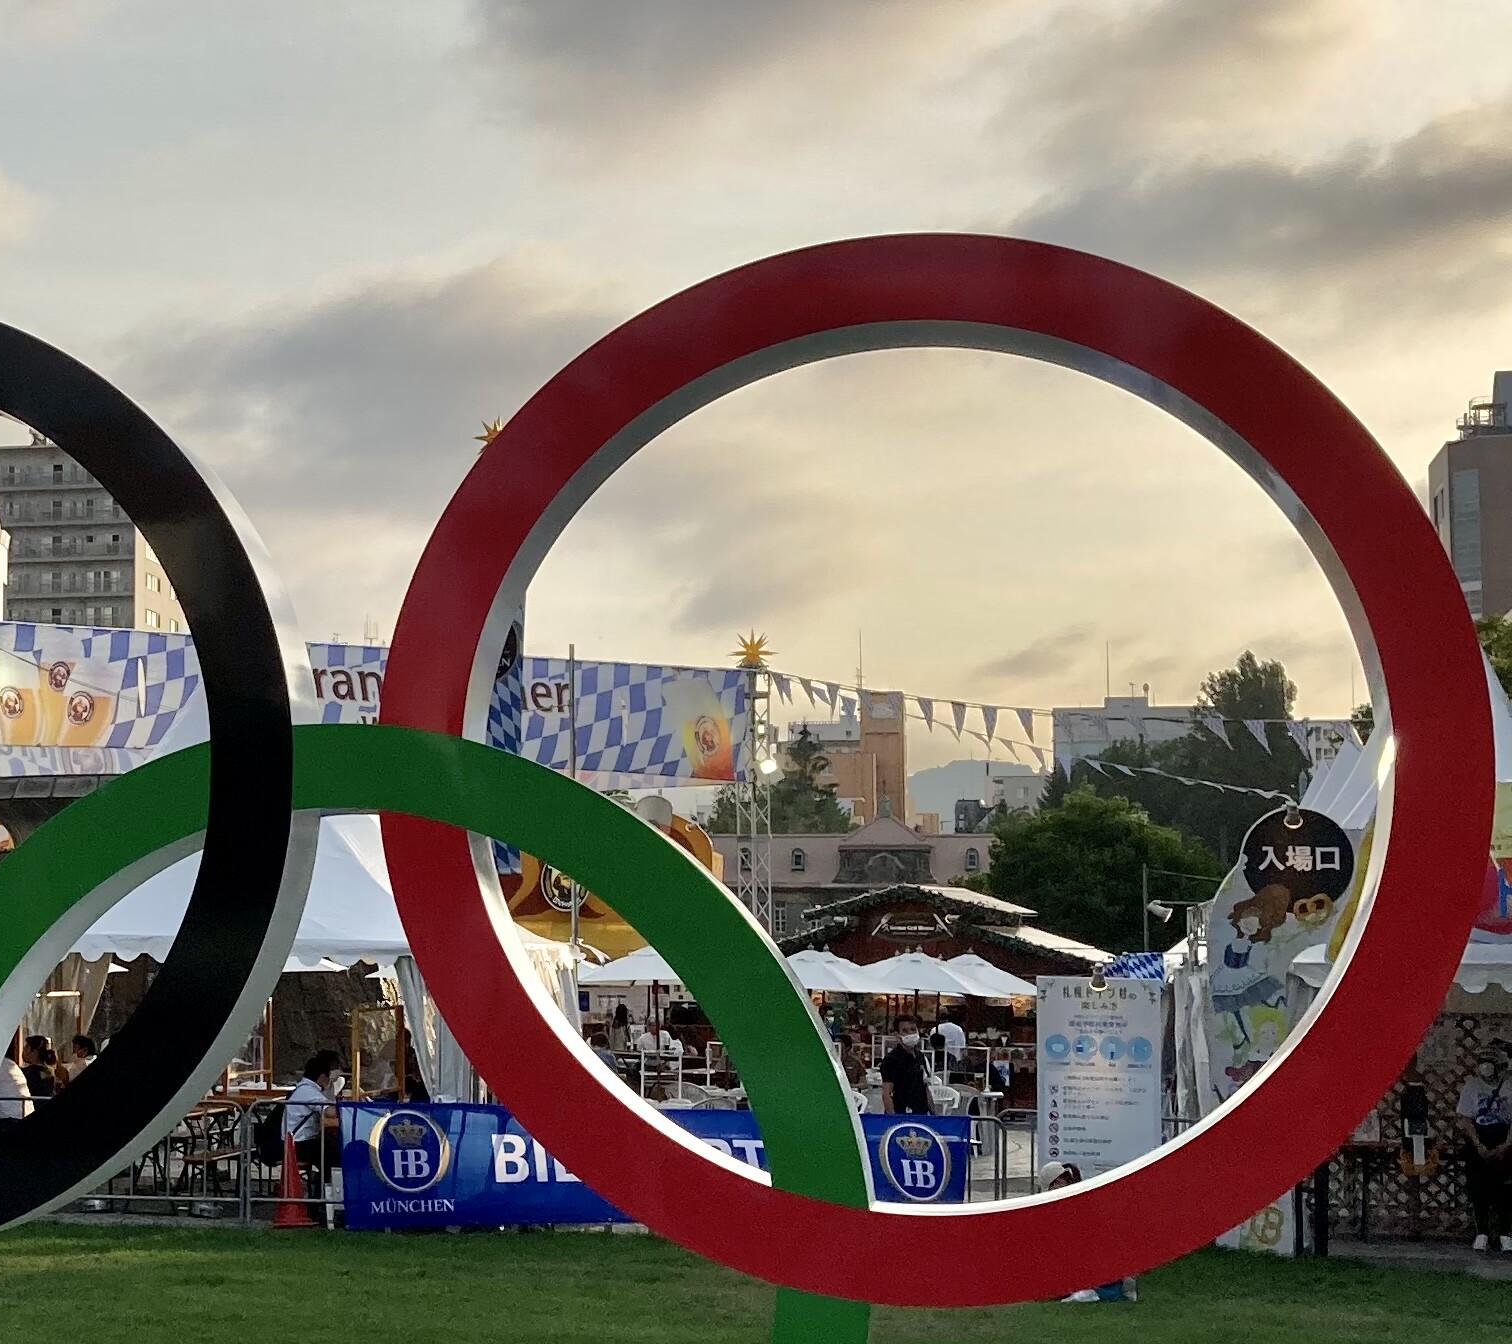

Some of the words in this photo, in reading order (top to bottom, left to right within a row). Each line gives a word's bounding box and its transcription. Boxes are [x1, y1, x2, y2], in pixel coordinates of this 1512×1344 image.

[1258, 845, 1341, 872] 入場口
[391, 1148, 431, 1180] HB
[900, 1158, 936, 1189] HB
[370, 1198, 456, 1215] MÜNCHEN
